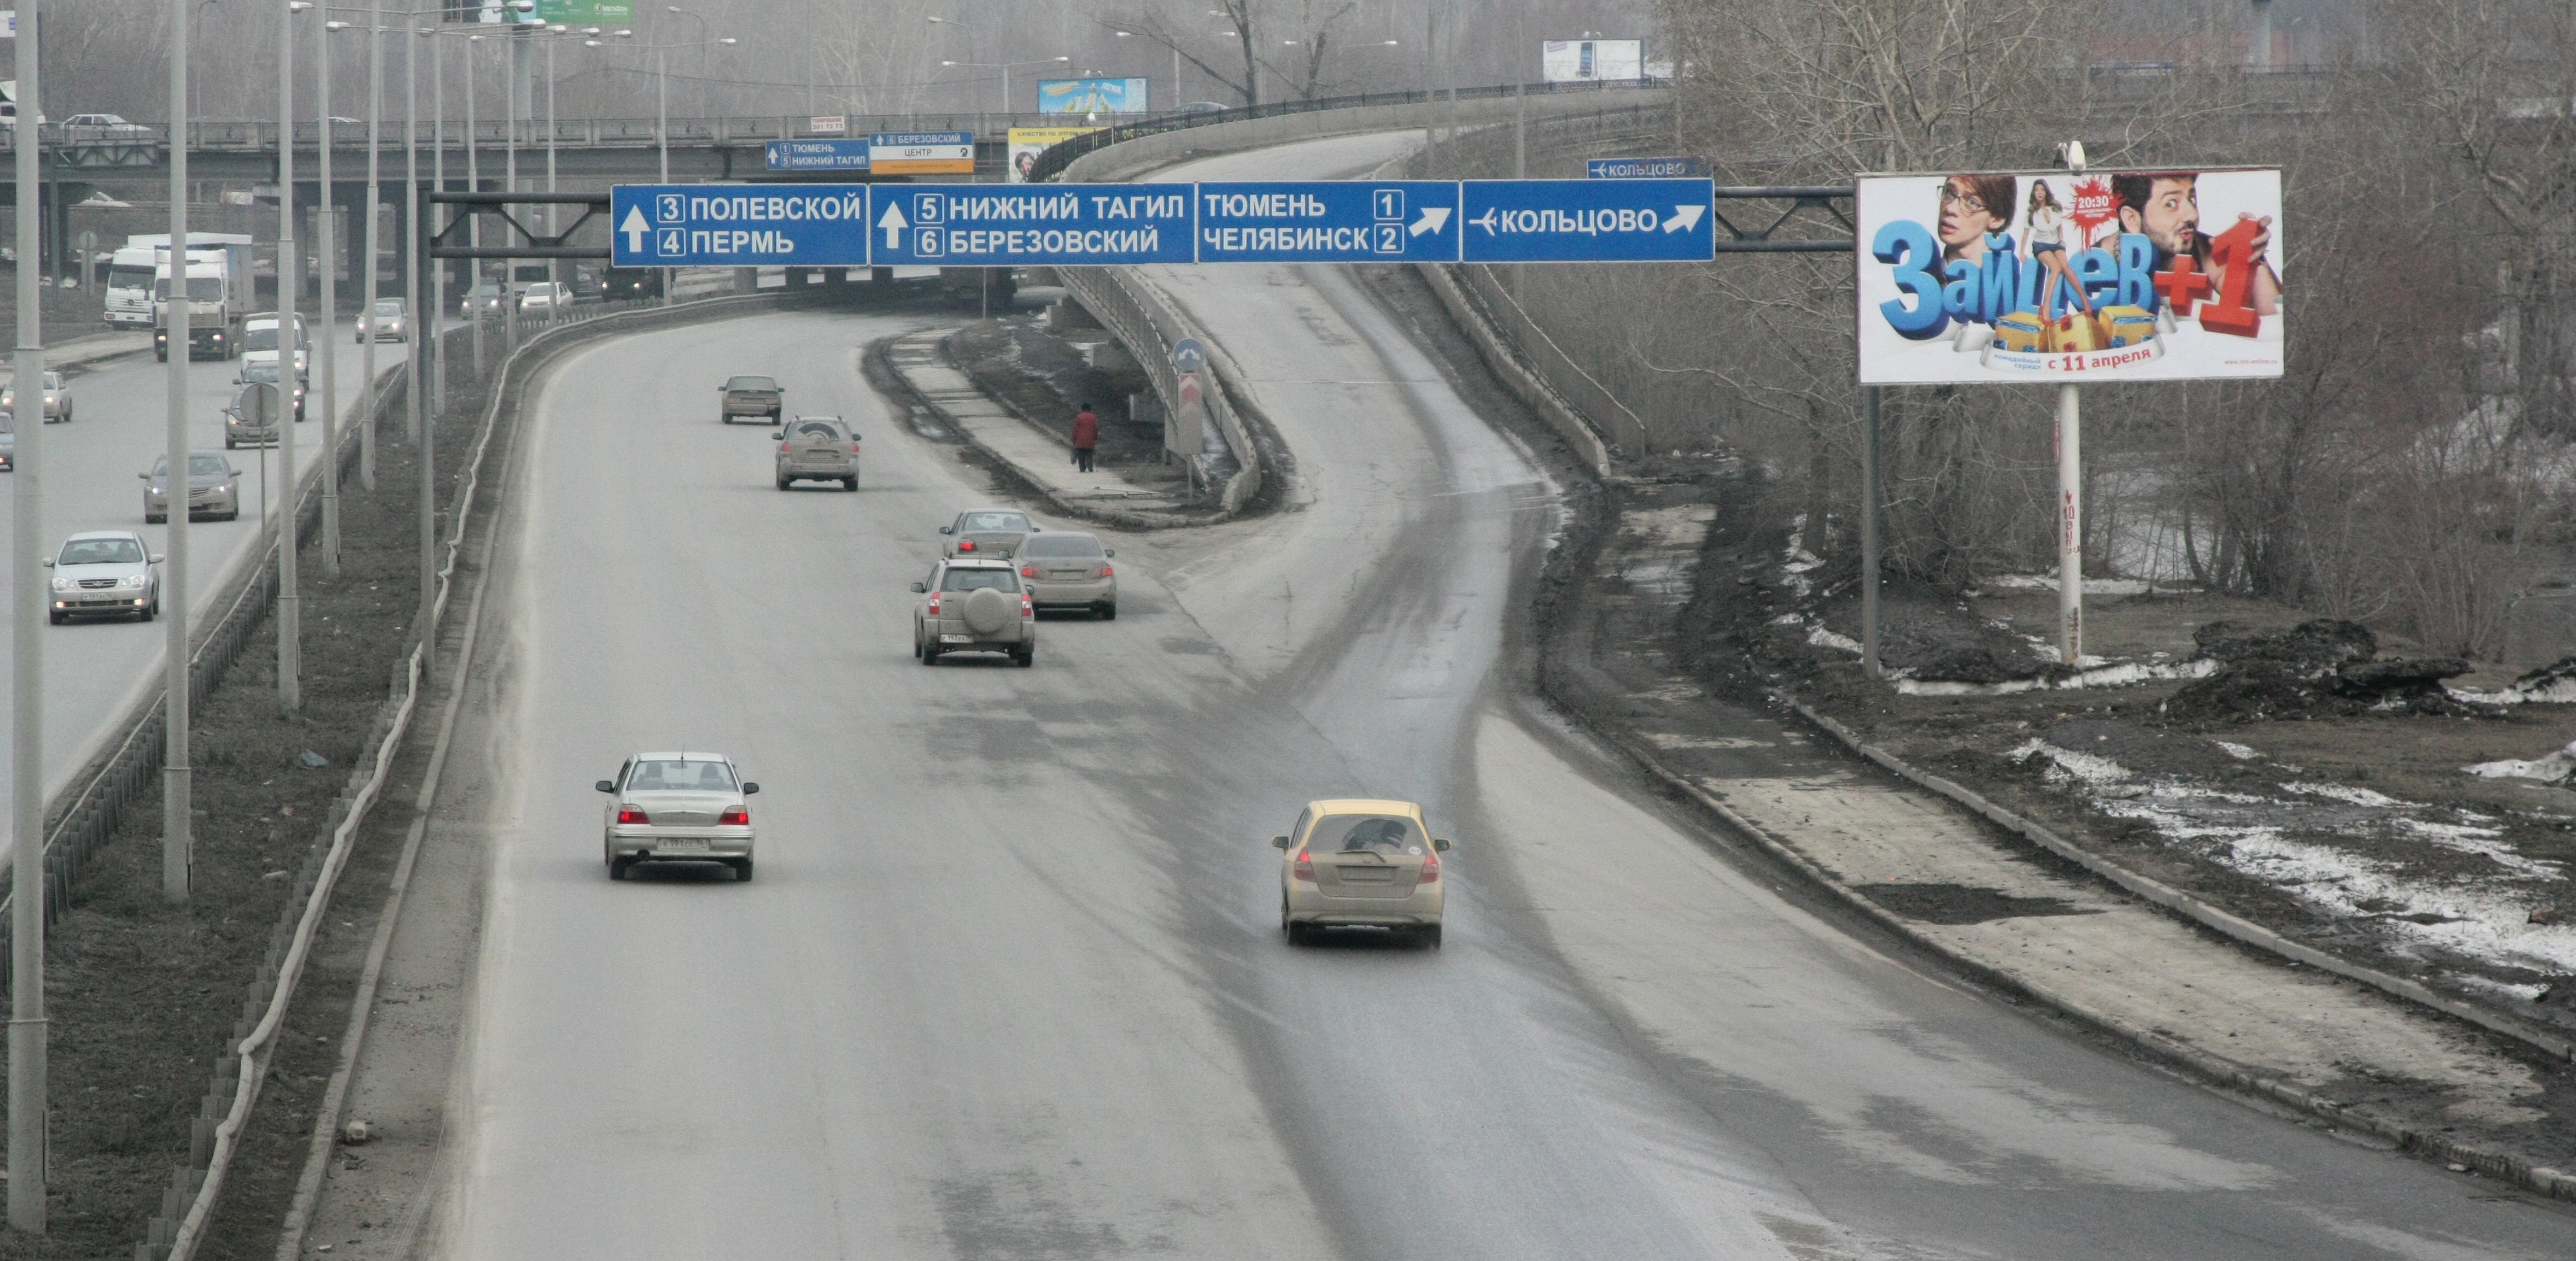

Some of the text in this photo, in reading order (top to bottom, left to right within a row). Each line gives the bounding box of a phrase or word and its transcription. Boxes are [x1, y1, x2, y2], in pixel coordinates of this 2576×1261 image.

[792, 144, 835, 153] ТЮМЕНЬ
[898, 133, 961, 143] БЕРЕЗОВСКИЙ
[792, 155, 834, 165] НИЖНИЙ
[836, 156, 865, 165] ТАГИЛ
[904, 148, 932, 157] ЦЕНТР
[1609, 163, 1686, 177] КОЛЬЦОВО
[665, 192, 860, 221] 3 ПОЛЕВСКОЙ
[922, 192, 1184, 220] 5 НИЖНИЙ ТАГИЛ
[1205, 193, 1392, 217] ТЮМЕНЬ 1
[2078, 195, 2109, 209] 20:30
[1502, 209, 1658, 236] КОЛЬЦОВО
[663, 230, 794, 253] 4 ПЕРМЬ
[921, 225, 1158, 253] 6 БЕРЕЗОВСКИЙ
[1204, 227, 1397, 250] ЧЕЛЯБИНСК 2
[1994, 353, 2041, 363] комедийный
[2048, 348, 2151, 371] с 11 апреля
